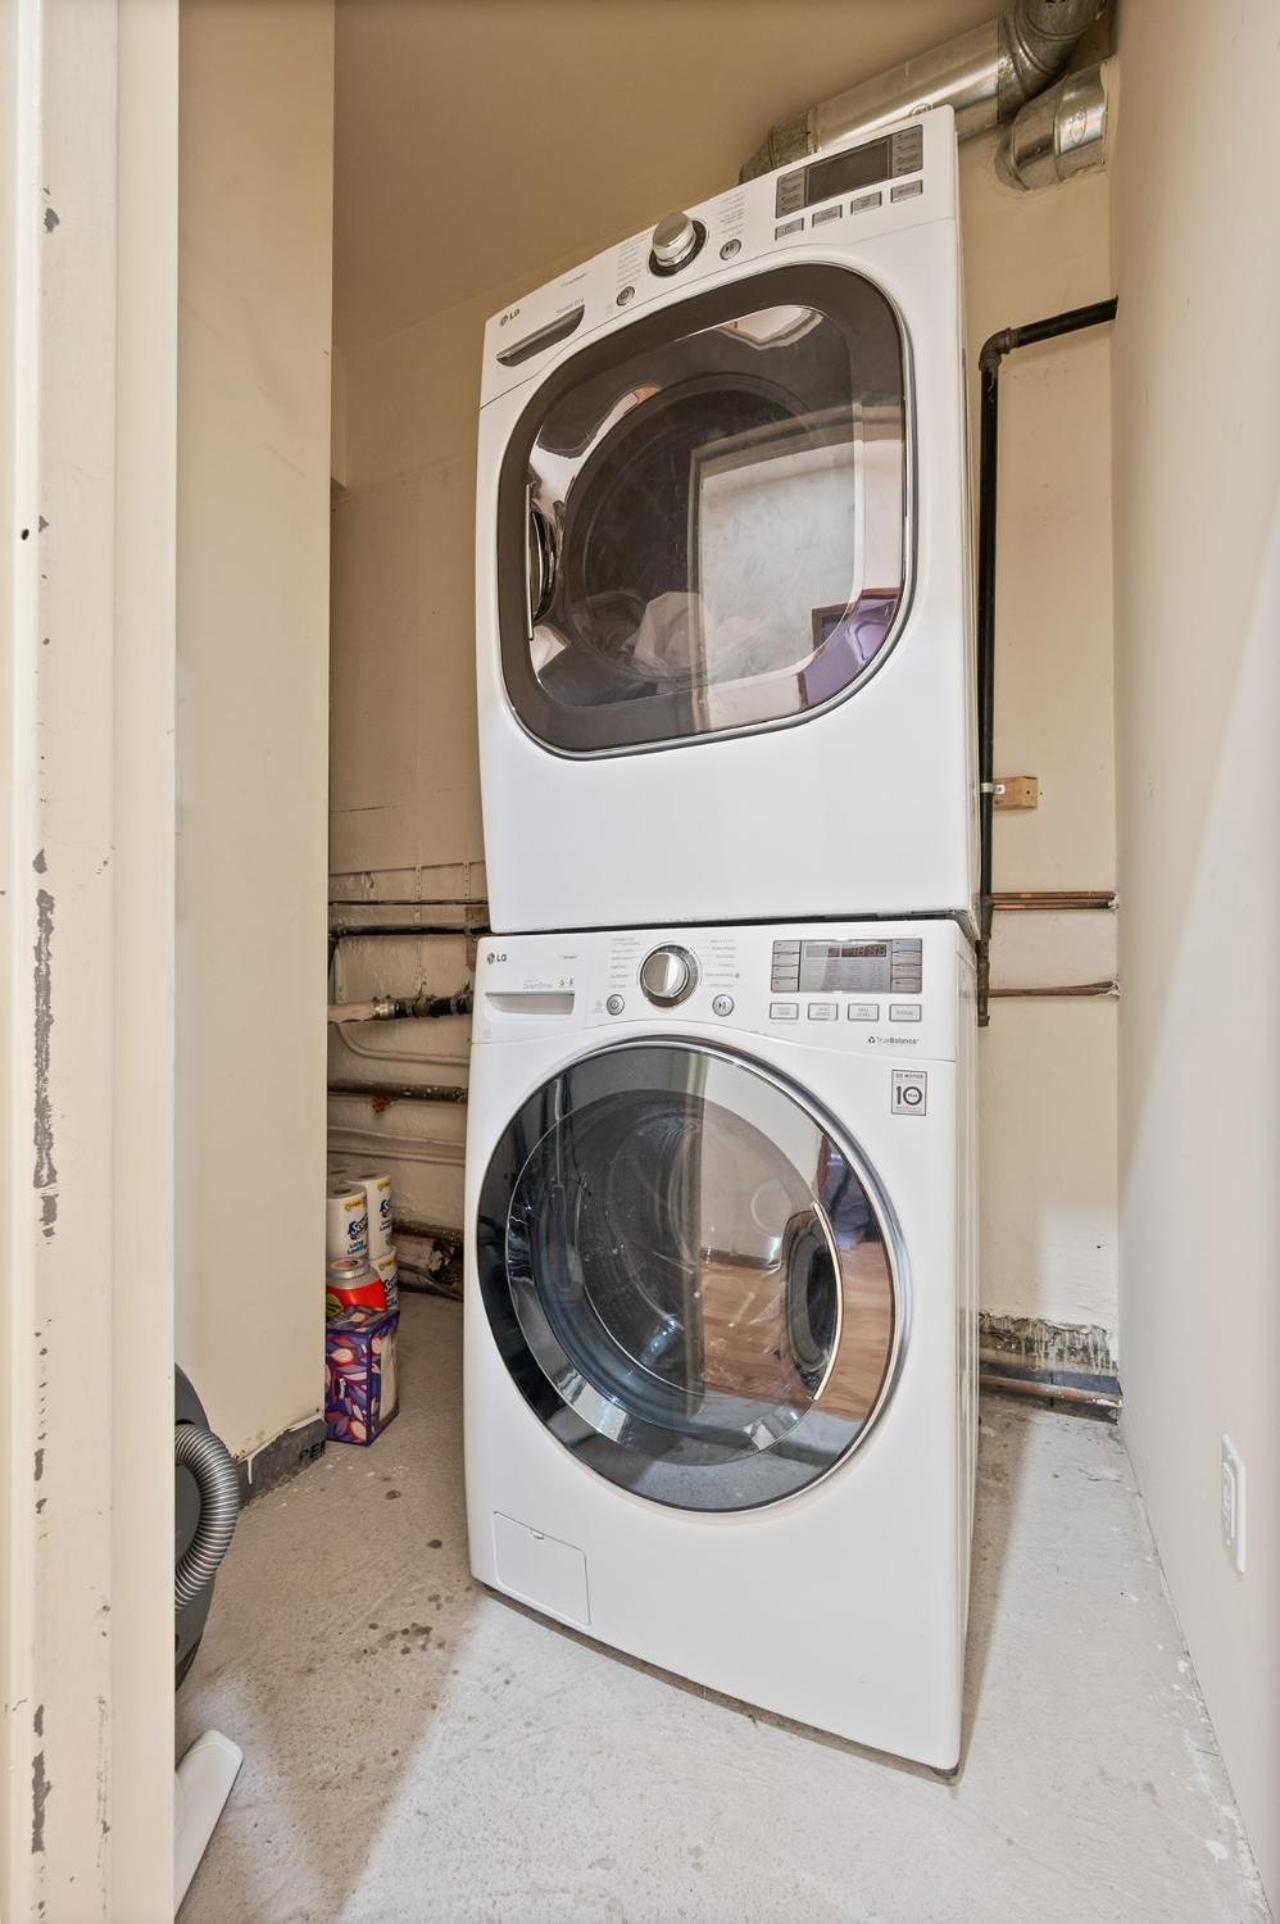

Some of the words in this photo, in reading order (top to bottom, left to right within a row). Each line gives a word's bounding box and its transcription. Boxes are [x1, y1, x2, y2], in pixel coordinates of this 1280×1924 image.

[509, 308, 520, 320] LG
[496, 953, 508, 962] LG
[896, 1085, 923, 1106] 10
